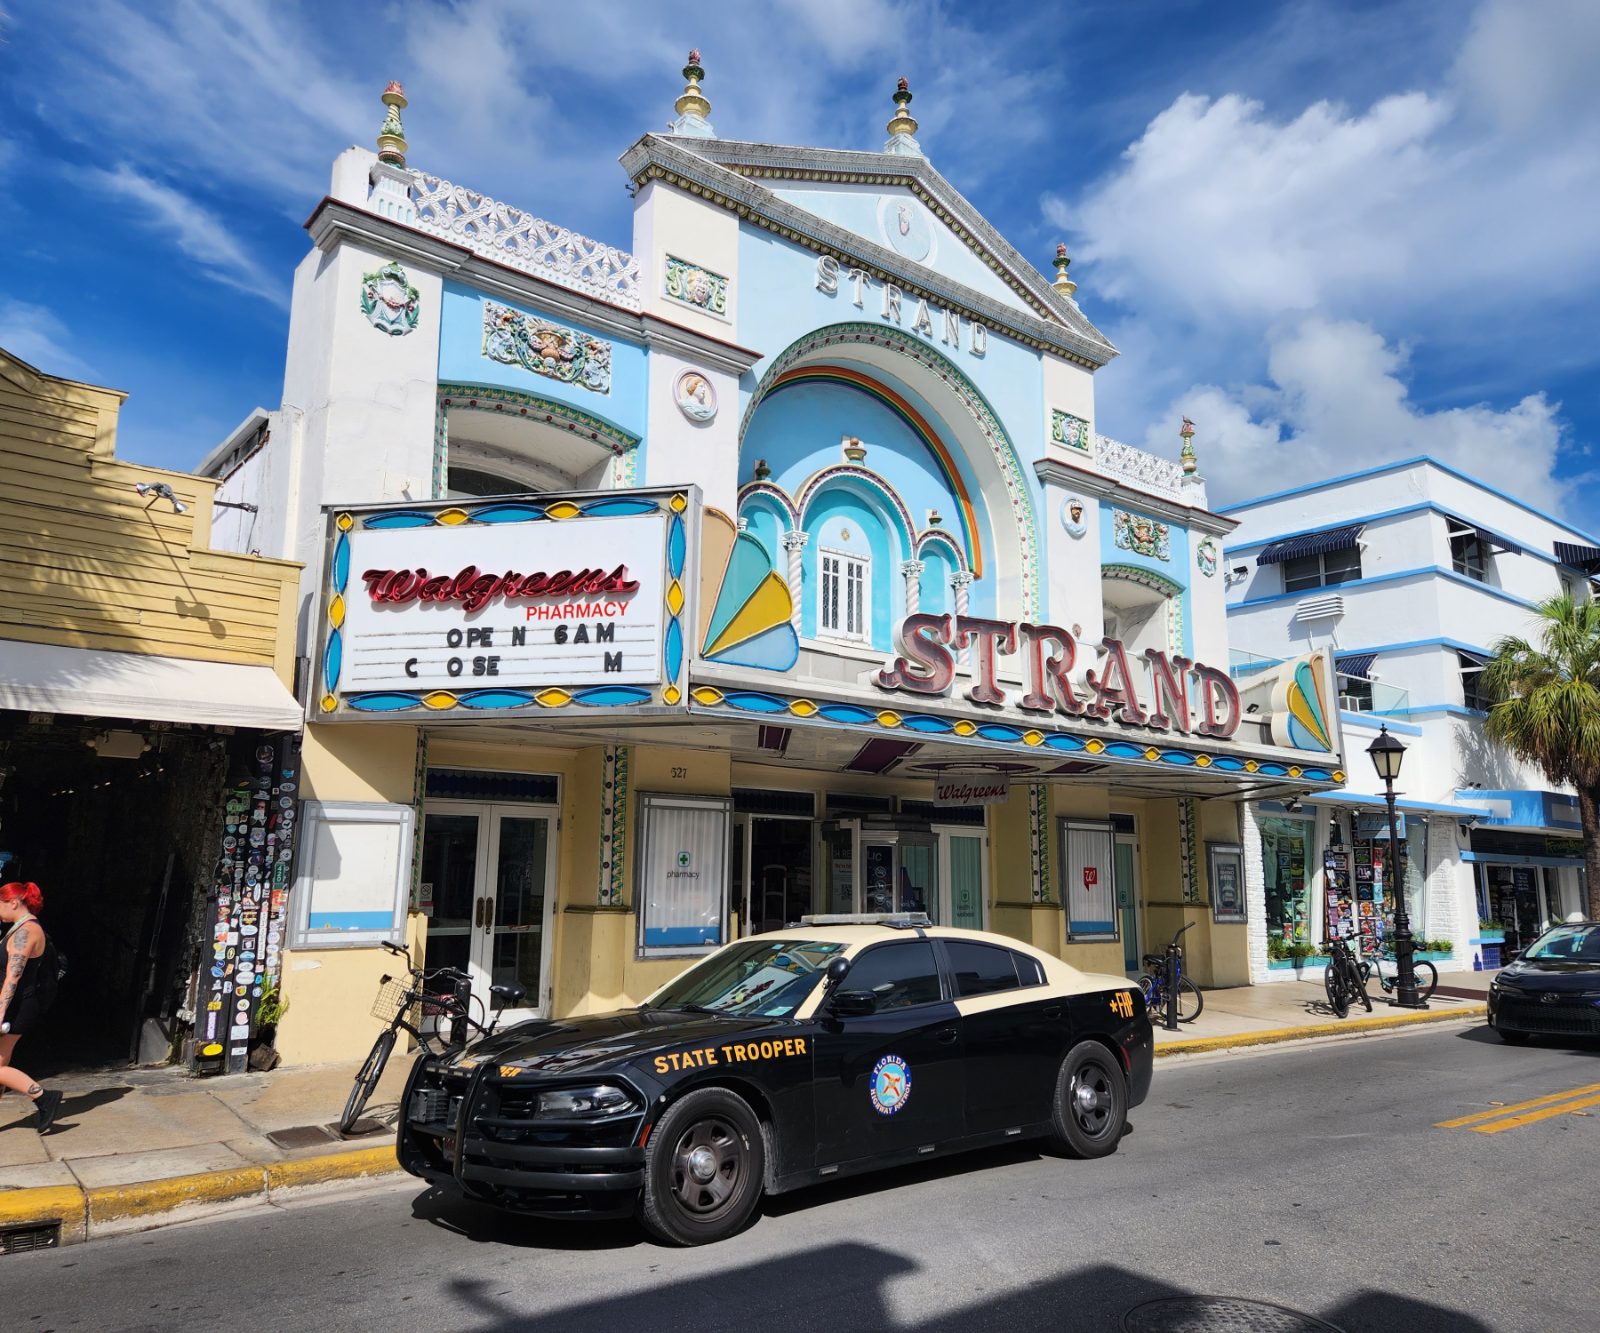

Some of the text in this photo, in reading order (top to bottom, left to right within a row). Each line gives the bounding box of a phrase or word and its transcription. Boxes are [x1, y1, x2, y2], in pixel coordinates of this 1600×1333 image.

[816, 255, 988, 356] STRAND
[361, 563, 641, 613] Walgreens
[526, 601, 629, 621] PHARMACY
[603, 651, 623, 673] M
[871, 613, 1243, 739] STRAND
[937, 777, 1007, 804] Walgreens
[666, 870, 700, 880] pharmacy
[654, 1038, 807, 1074] STATE TROOPER
[873, 1055, 907, 1075] FLORIDA
[870, 1082, 912, 1115] HIGHWAY PATROL
